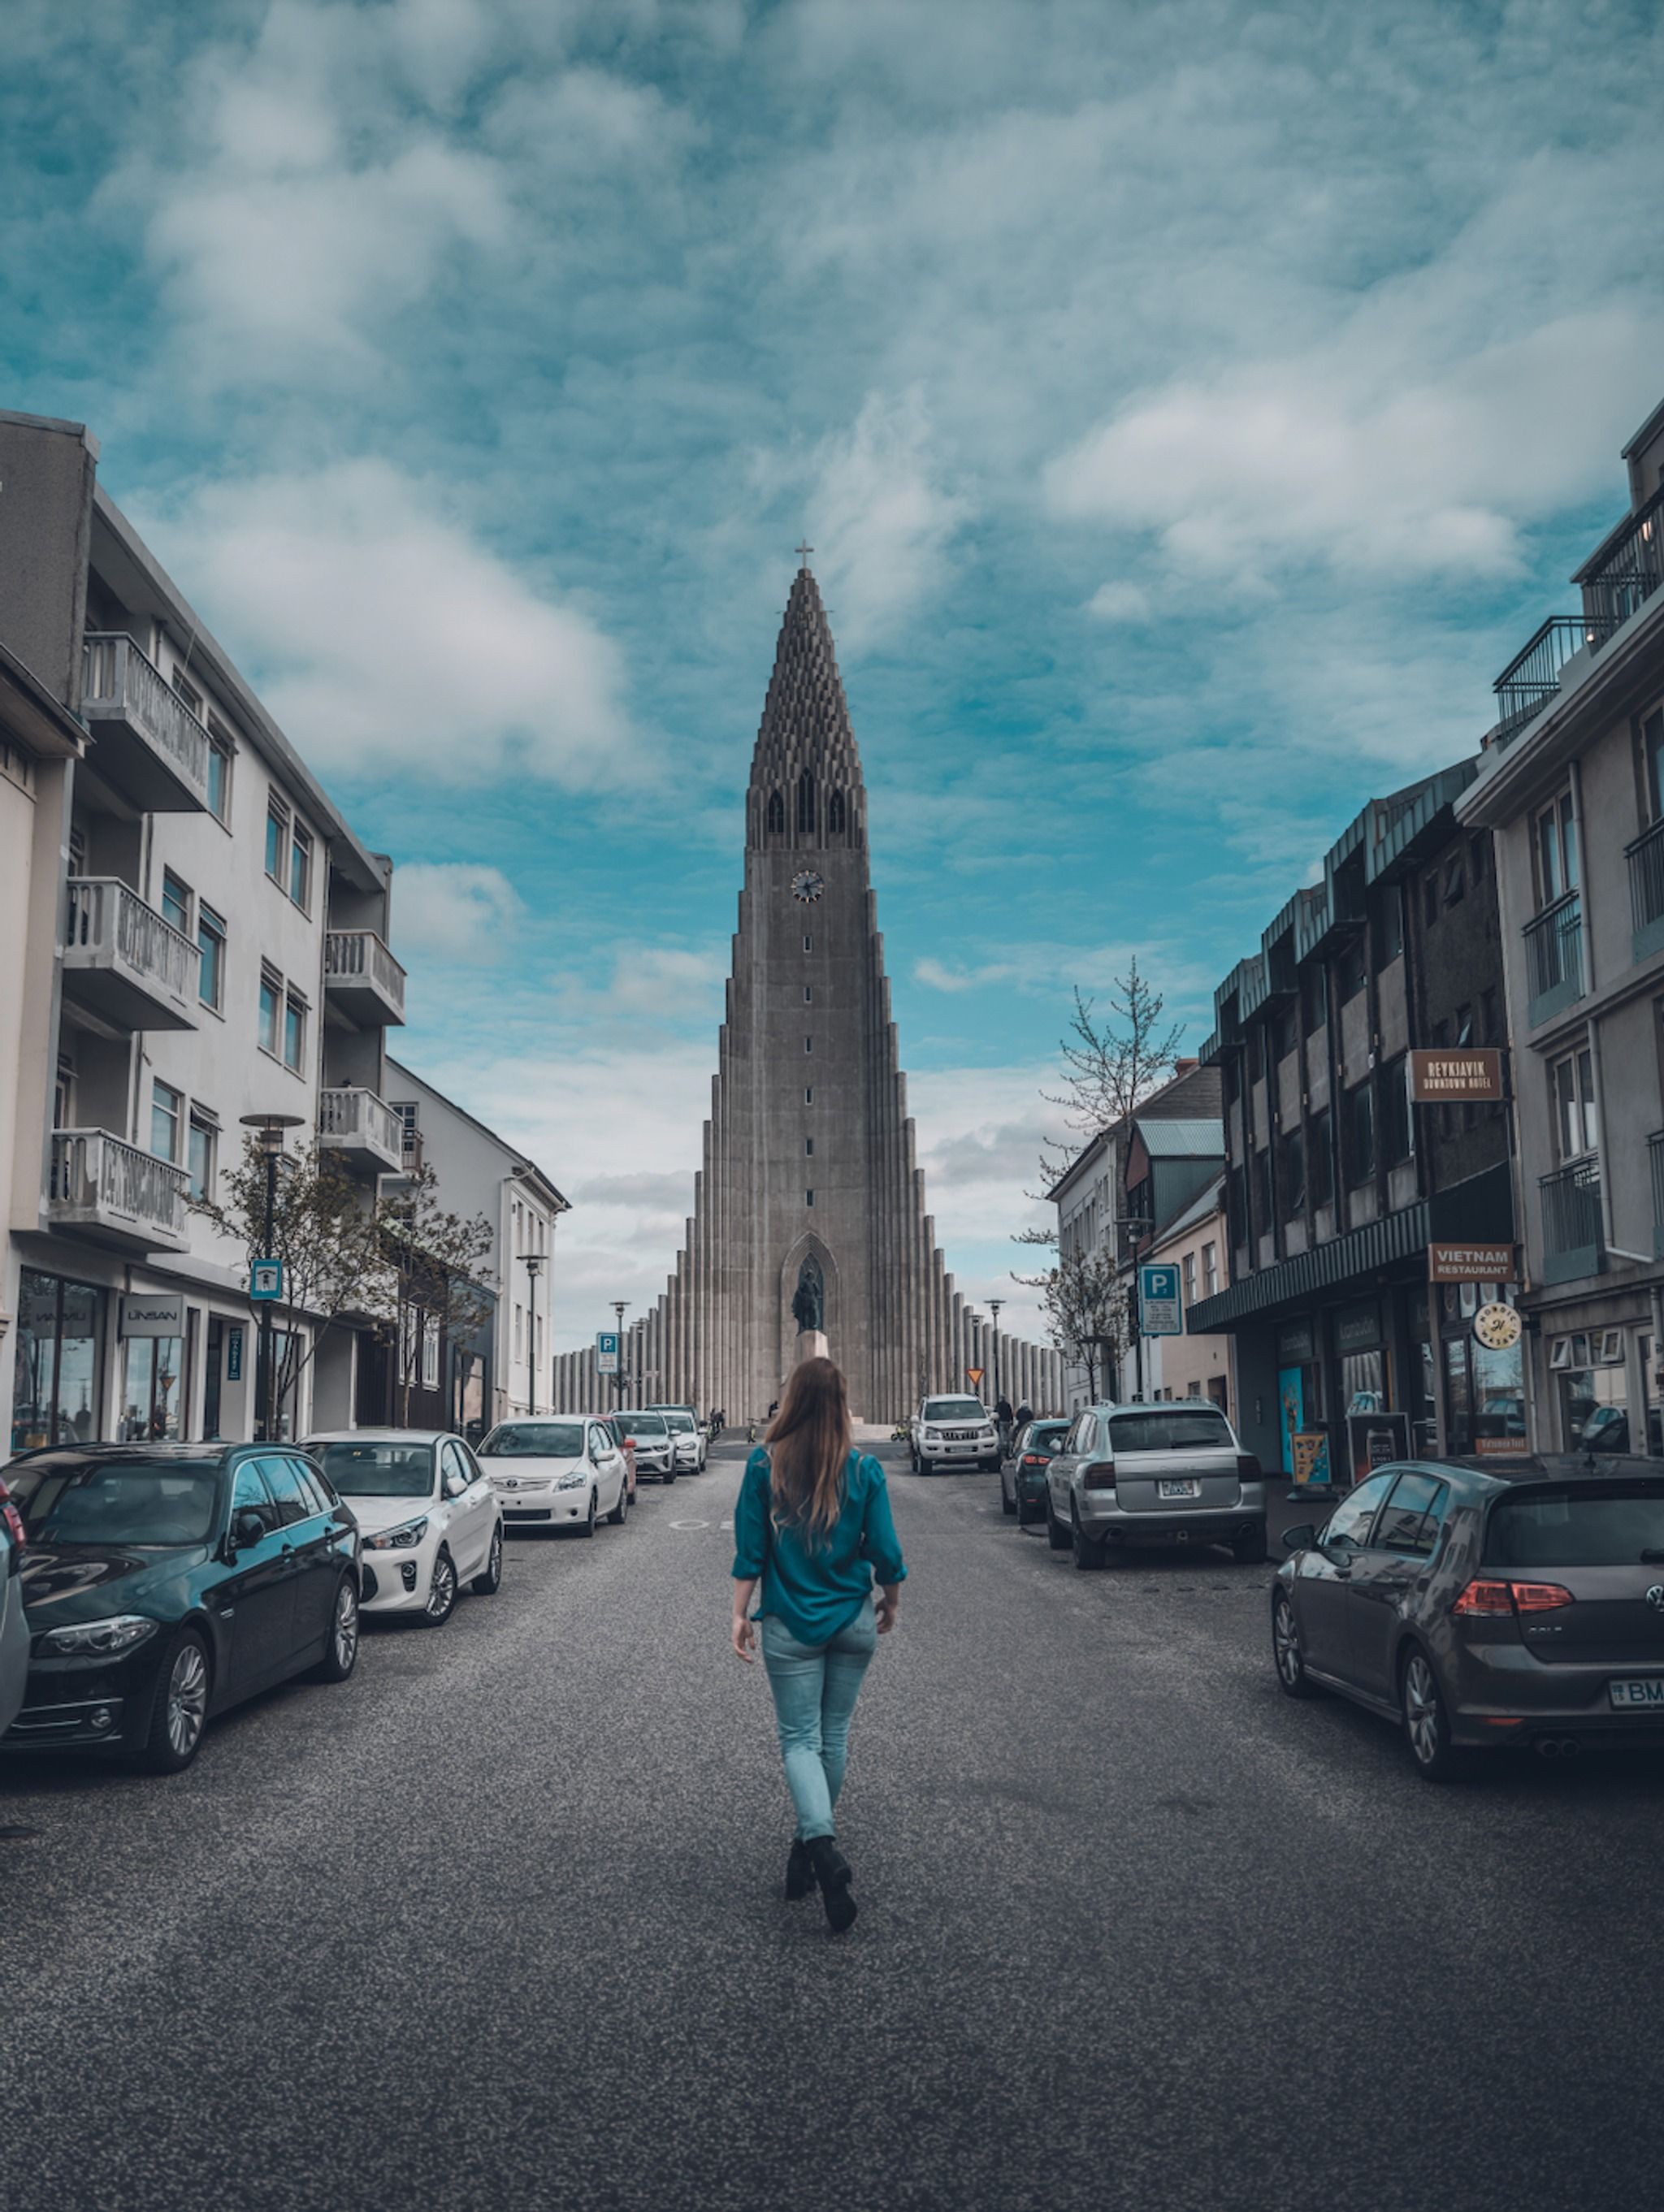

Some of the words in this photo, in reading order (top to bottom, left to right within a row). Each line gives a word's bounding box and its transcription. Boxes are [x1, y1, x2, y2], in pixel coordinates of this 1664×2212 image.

[1423, 1078, 1466, 1089] DOWNTOWN
[1467, 1077, 1492, 1089] HOTEL
[1436, 1250, 1508, 1262] VIETNAM
[1437, 1265, 1509, 1275] RESTAURANT
[1152, 1274, 1168, 1294] P
[1480, 1305, 1516, 1322] NORDIC
[1481, 1329, 1518, 1346] WASABI
[604, 1338, 613, 1351] P
